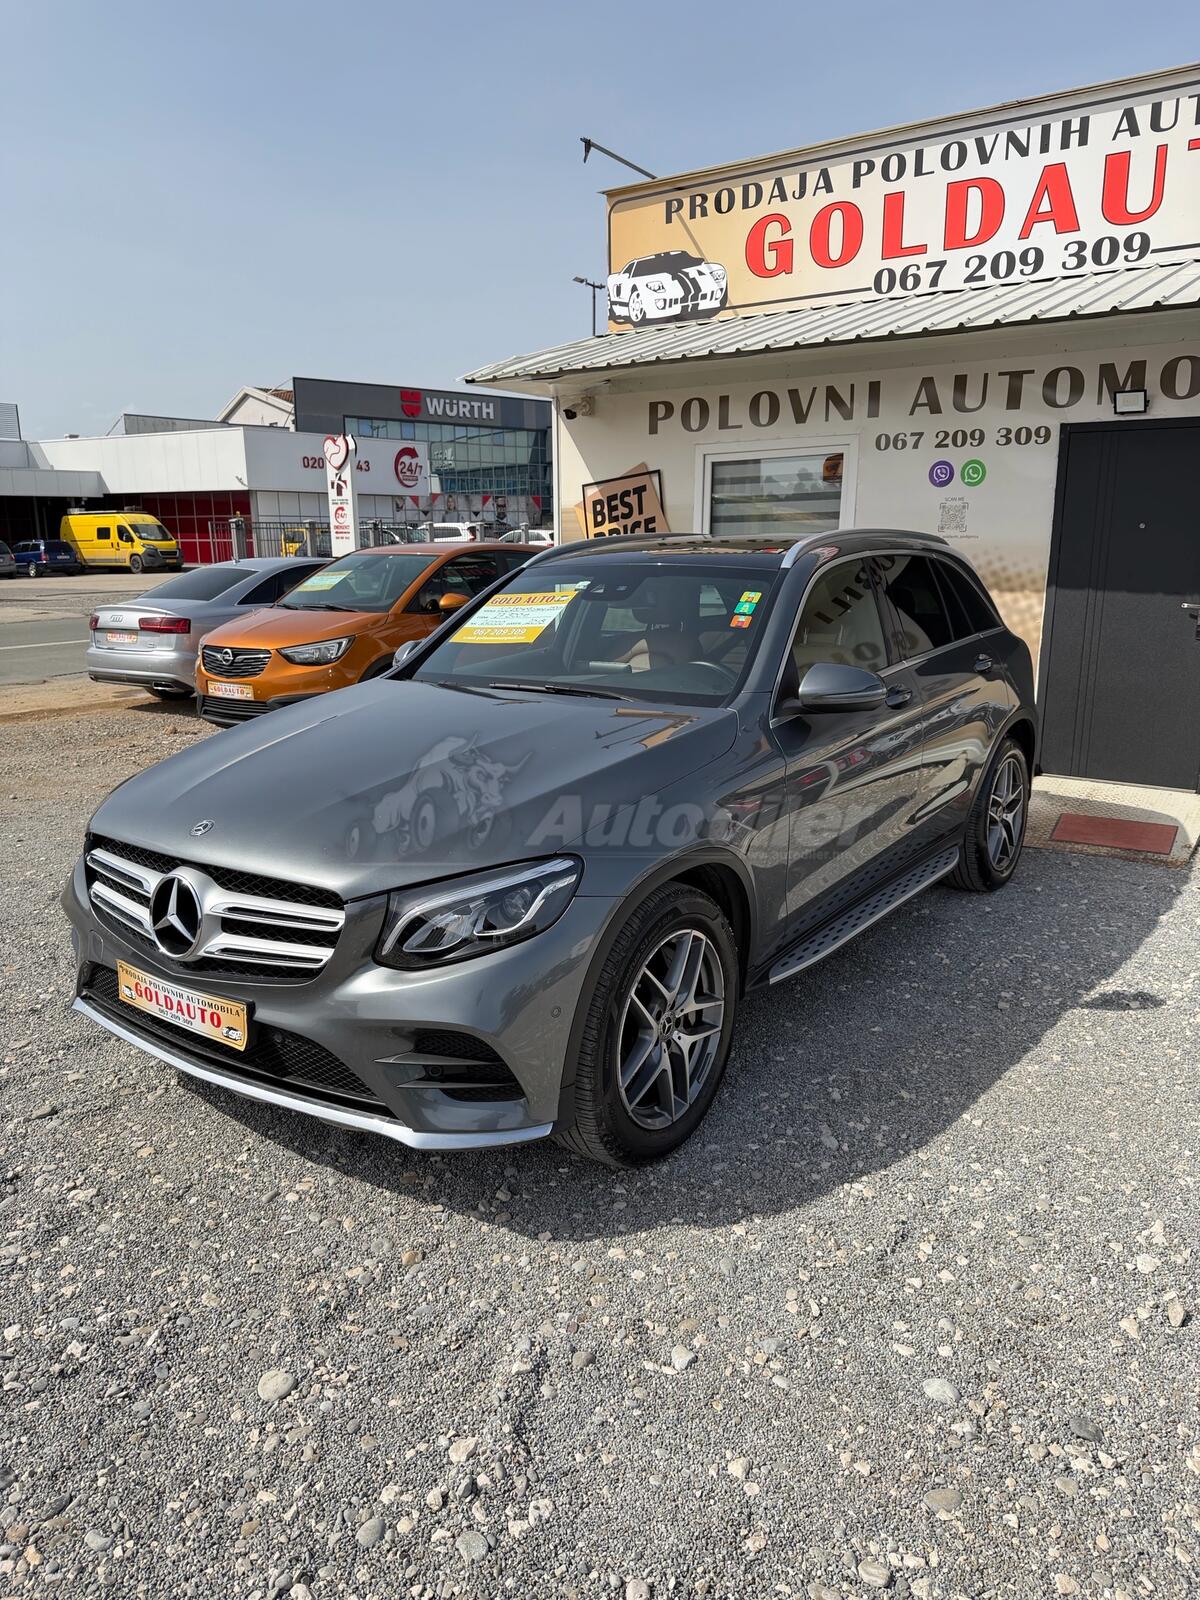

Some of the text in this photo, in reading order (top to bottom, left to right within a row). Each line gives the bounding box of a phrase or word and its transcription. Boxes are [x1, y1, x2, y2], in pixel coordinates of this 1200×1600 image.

[665, 168, 834, 224] PRODAJA
[852, 115, 1090, 189] POLOVNIH
[873, 232, 1151, 294] 067 209 309
[426, 397, 494, 420] WÜRTH
[648, 355, 1200, 435] POLOVNI AUTOMO
[875, 426, 1051, 451] 067 209 309
[302, 456, 325, 469] 020
[592, 484, 647, 528] BEST
[491, 594, 555, 605] GOLD AUTO
[120, 966, 240, 1017] PRODAJA POLOVNIH AUTOMOBILA
[134, 981, 222, 1028] GOLDAUTO
